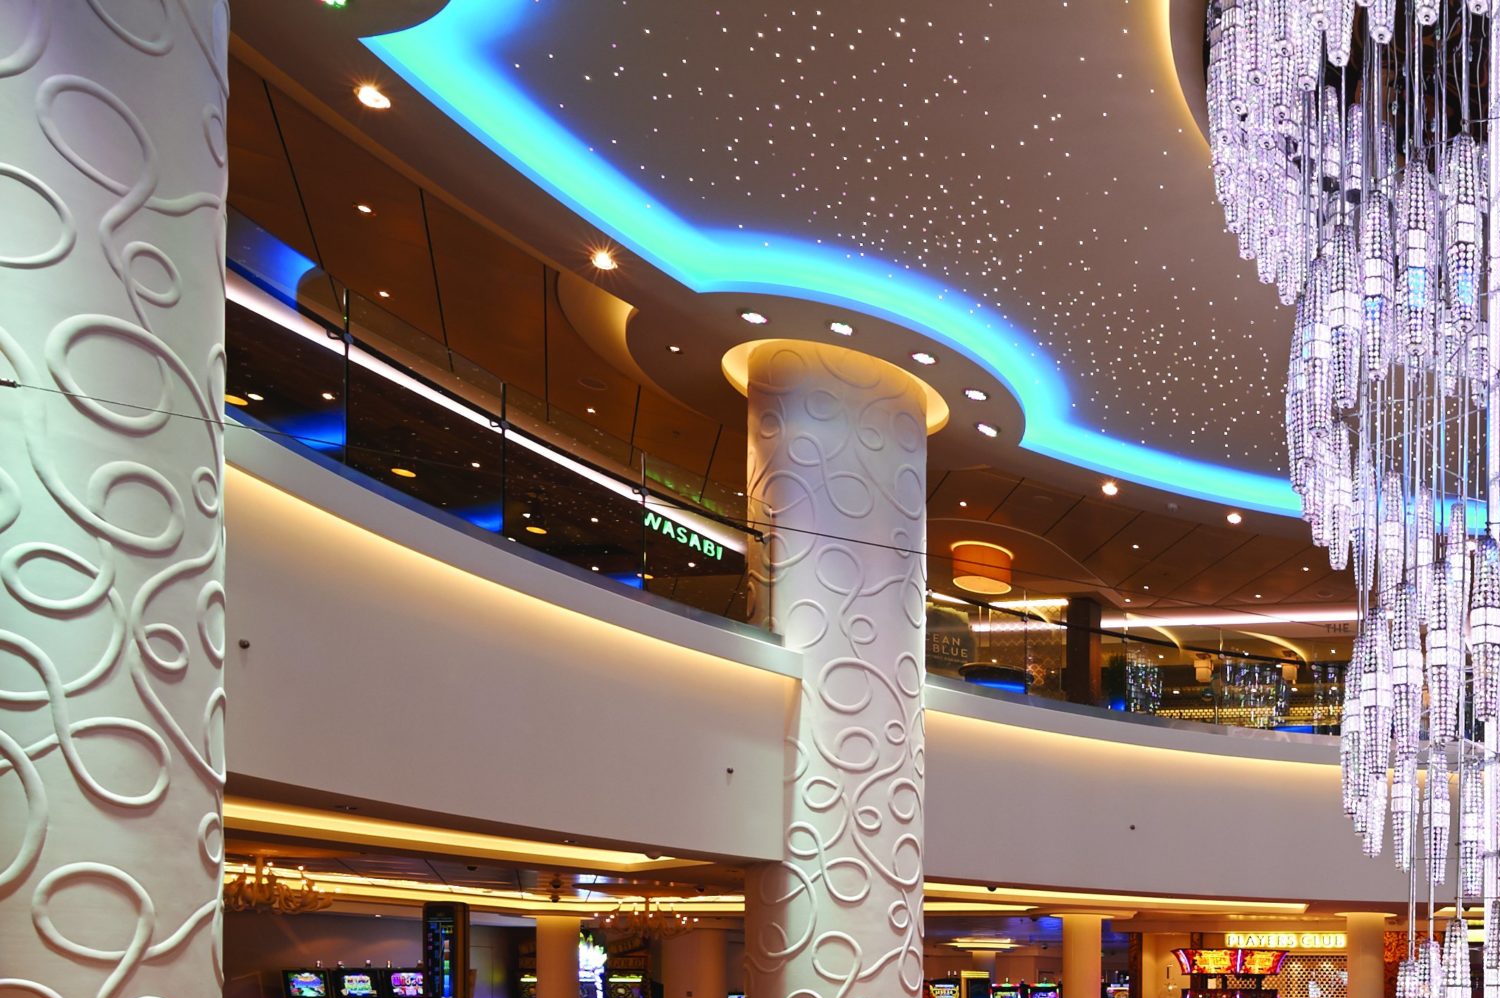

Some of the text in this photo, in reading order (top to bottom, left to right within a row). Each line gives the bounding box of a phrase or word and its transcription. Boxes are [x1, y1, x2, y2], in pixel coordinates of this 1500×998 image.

[643, 512, 723, 560] WASABI
[1325, 623, 1350, 633] THE
[932, 643, 968, 658] BLUE
[1226, 934, 1344, 947] PLAYERS CLUB
